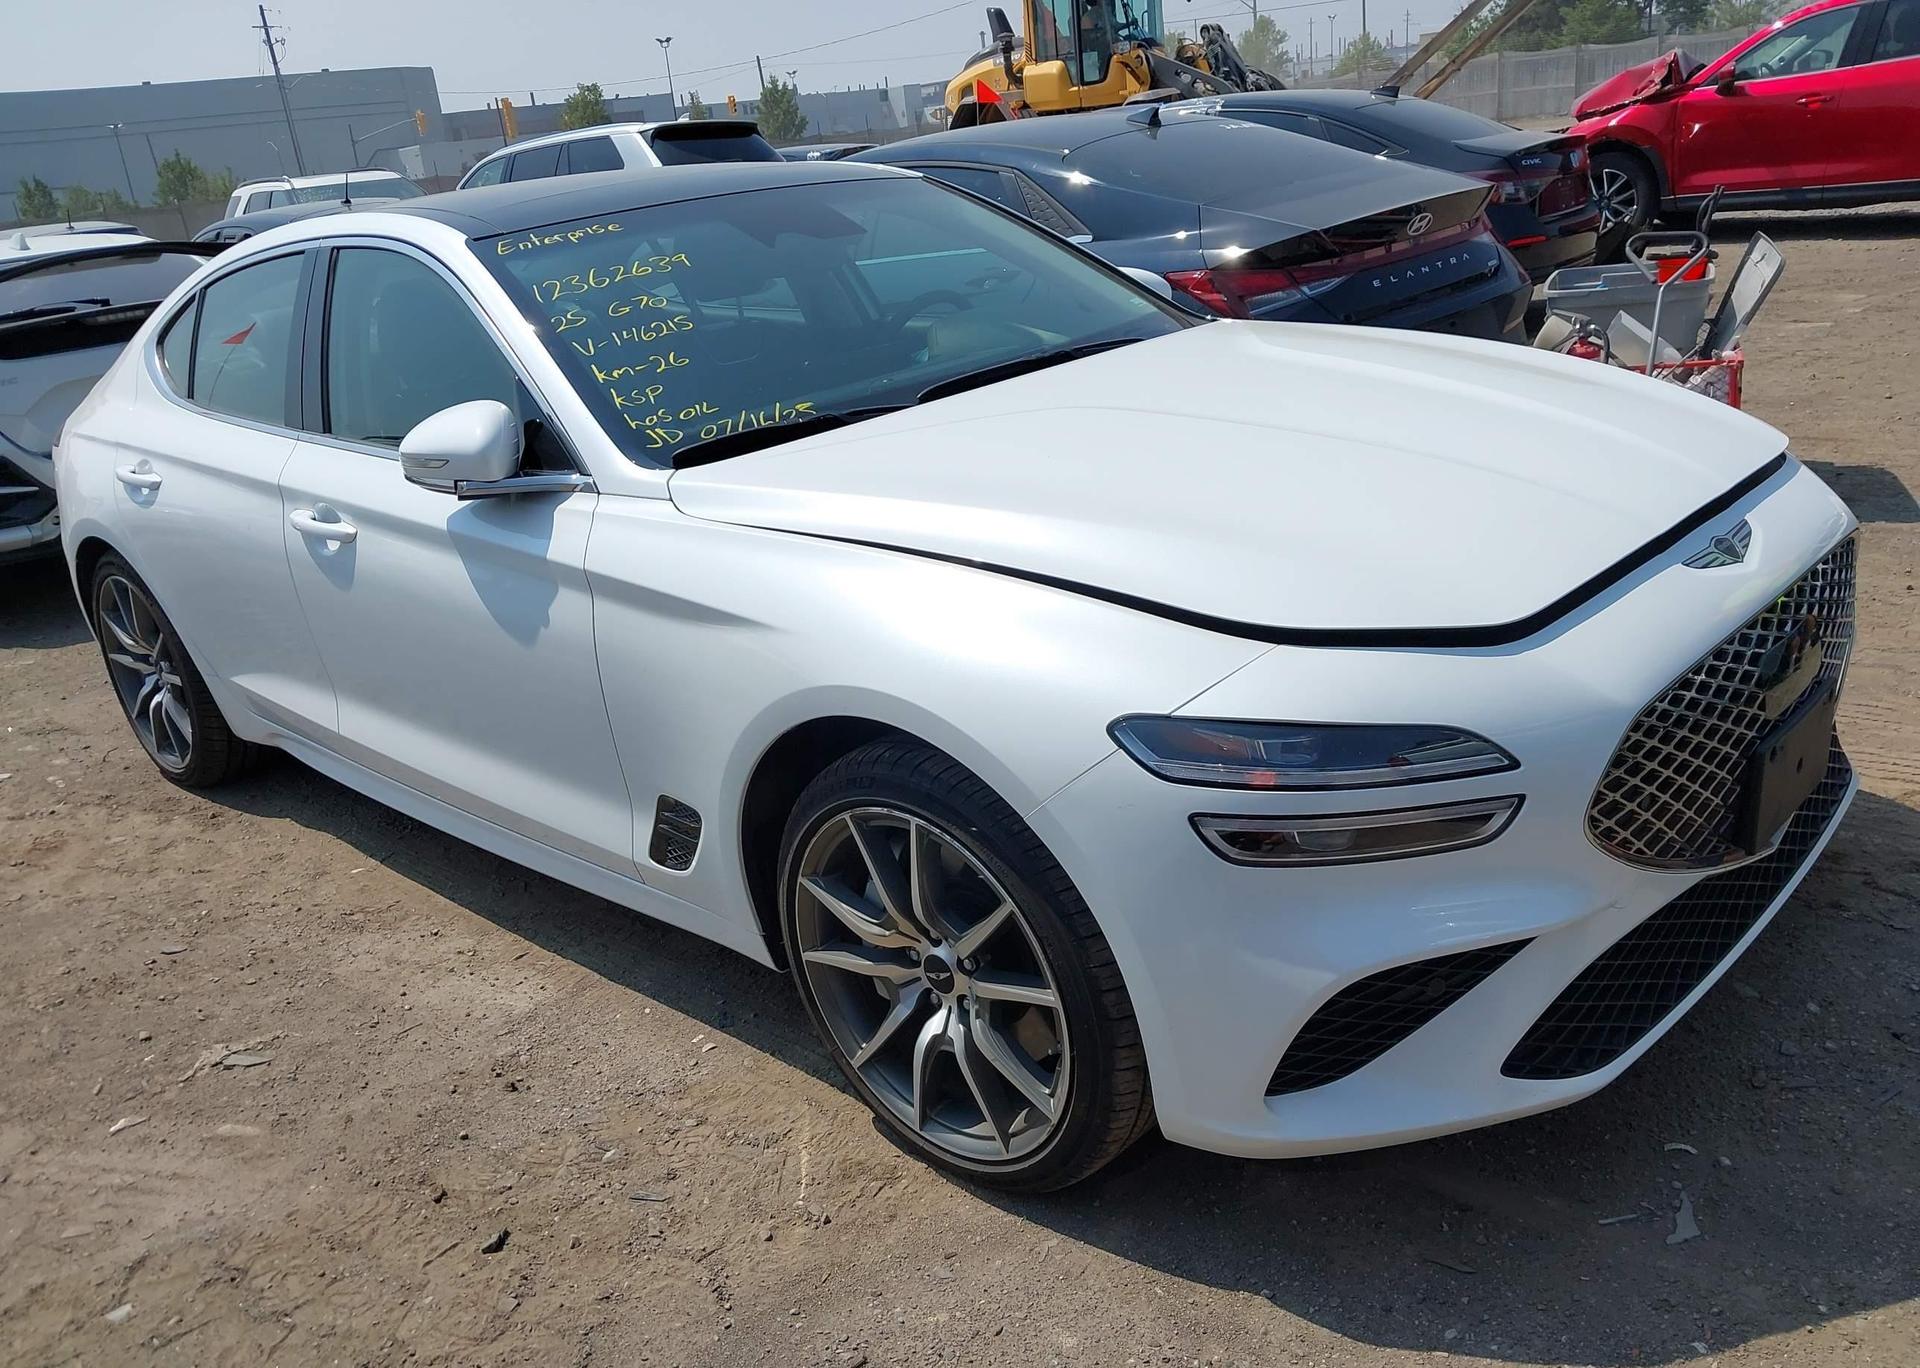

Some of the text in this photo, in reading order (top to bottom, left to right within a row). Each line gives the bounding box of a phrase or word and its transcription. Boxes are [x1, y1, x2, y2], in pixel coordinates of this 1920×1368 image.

[1521, 158, 1542, 166] CIVIC
[497, 223, 624, 255] Enterprise
[532, 253, 692, 303] 12362639
[1372, 253, 1470, 287] ELANTRA
[551, 295, 668, 334] 25 G70
[571, 315, 694, 356] V-146215
